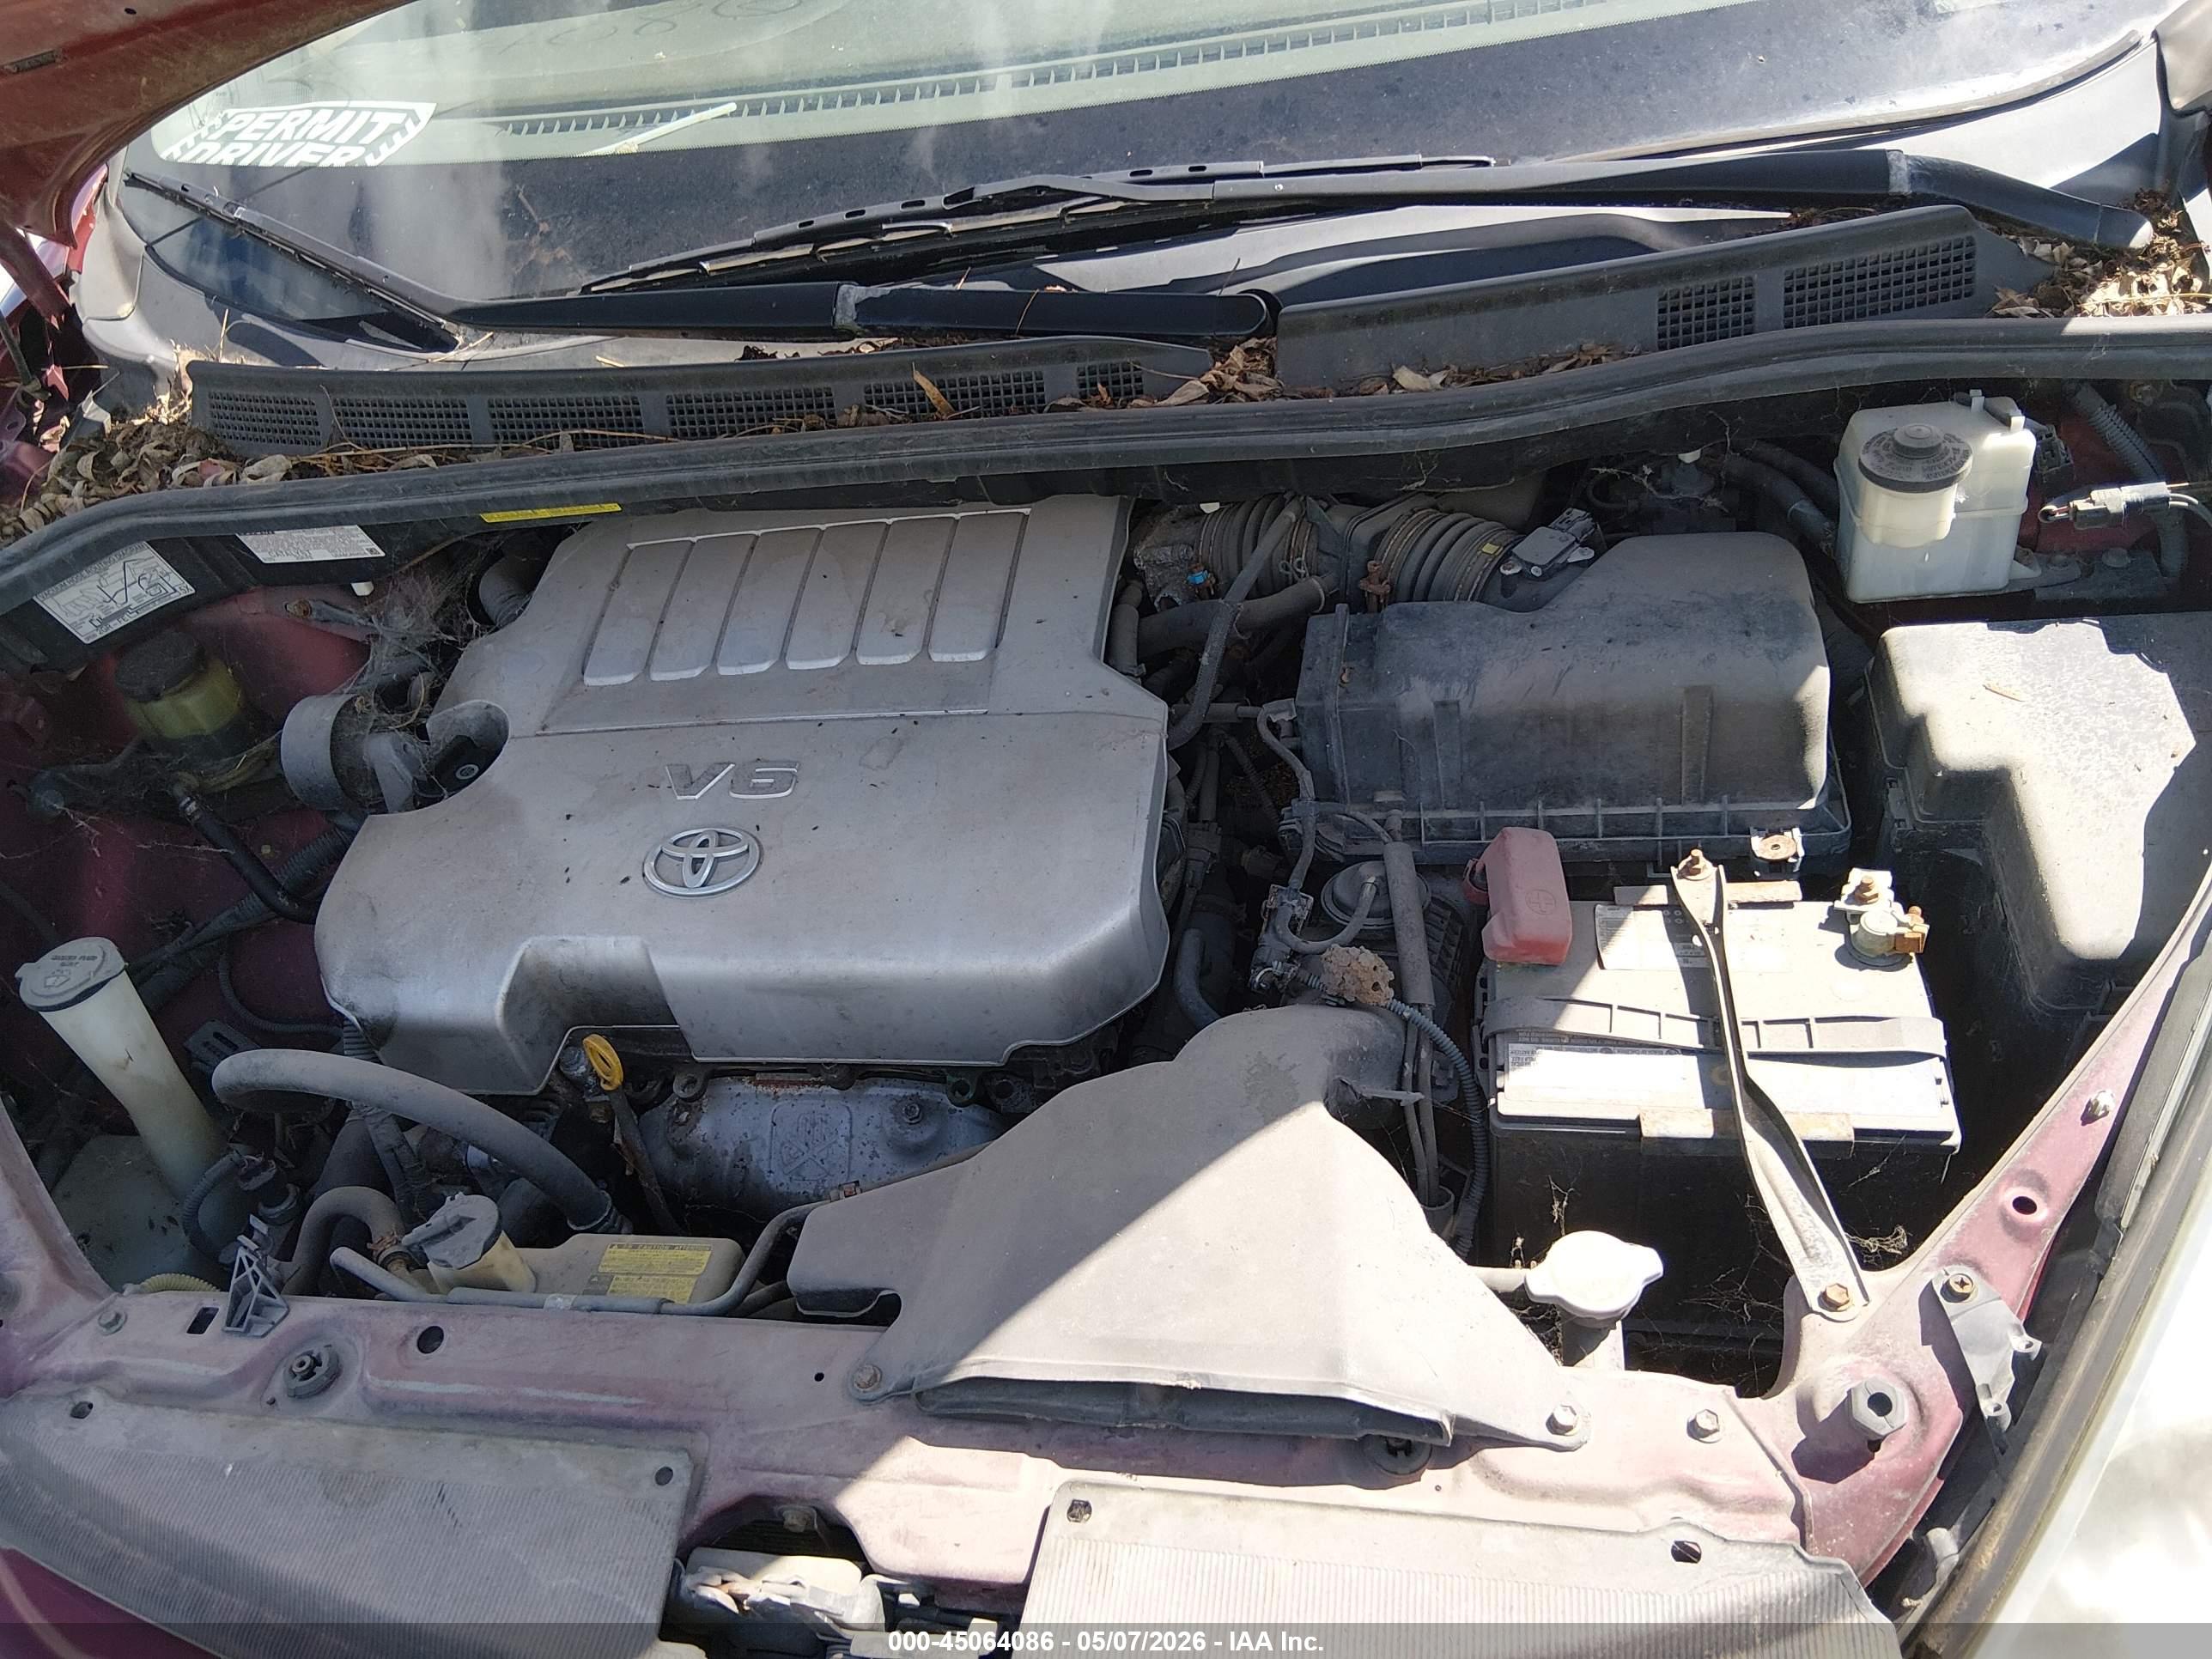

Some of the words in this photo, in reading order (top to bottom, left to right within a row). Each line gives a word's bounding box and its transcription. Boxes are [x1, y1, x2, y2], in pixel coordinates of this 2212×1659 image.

[206, 108, 407, 145] PERMIT
[175, 141, 366, 167] DRIVER
[268, 549, 311, 559] CATALYST
[665, 761, 800, 800] V6
